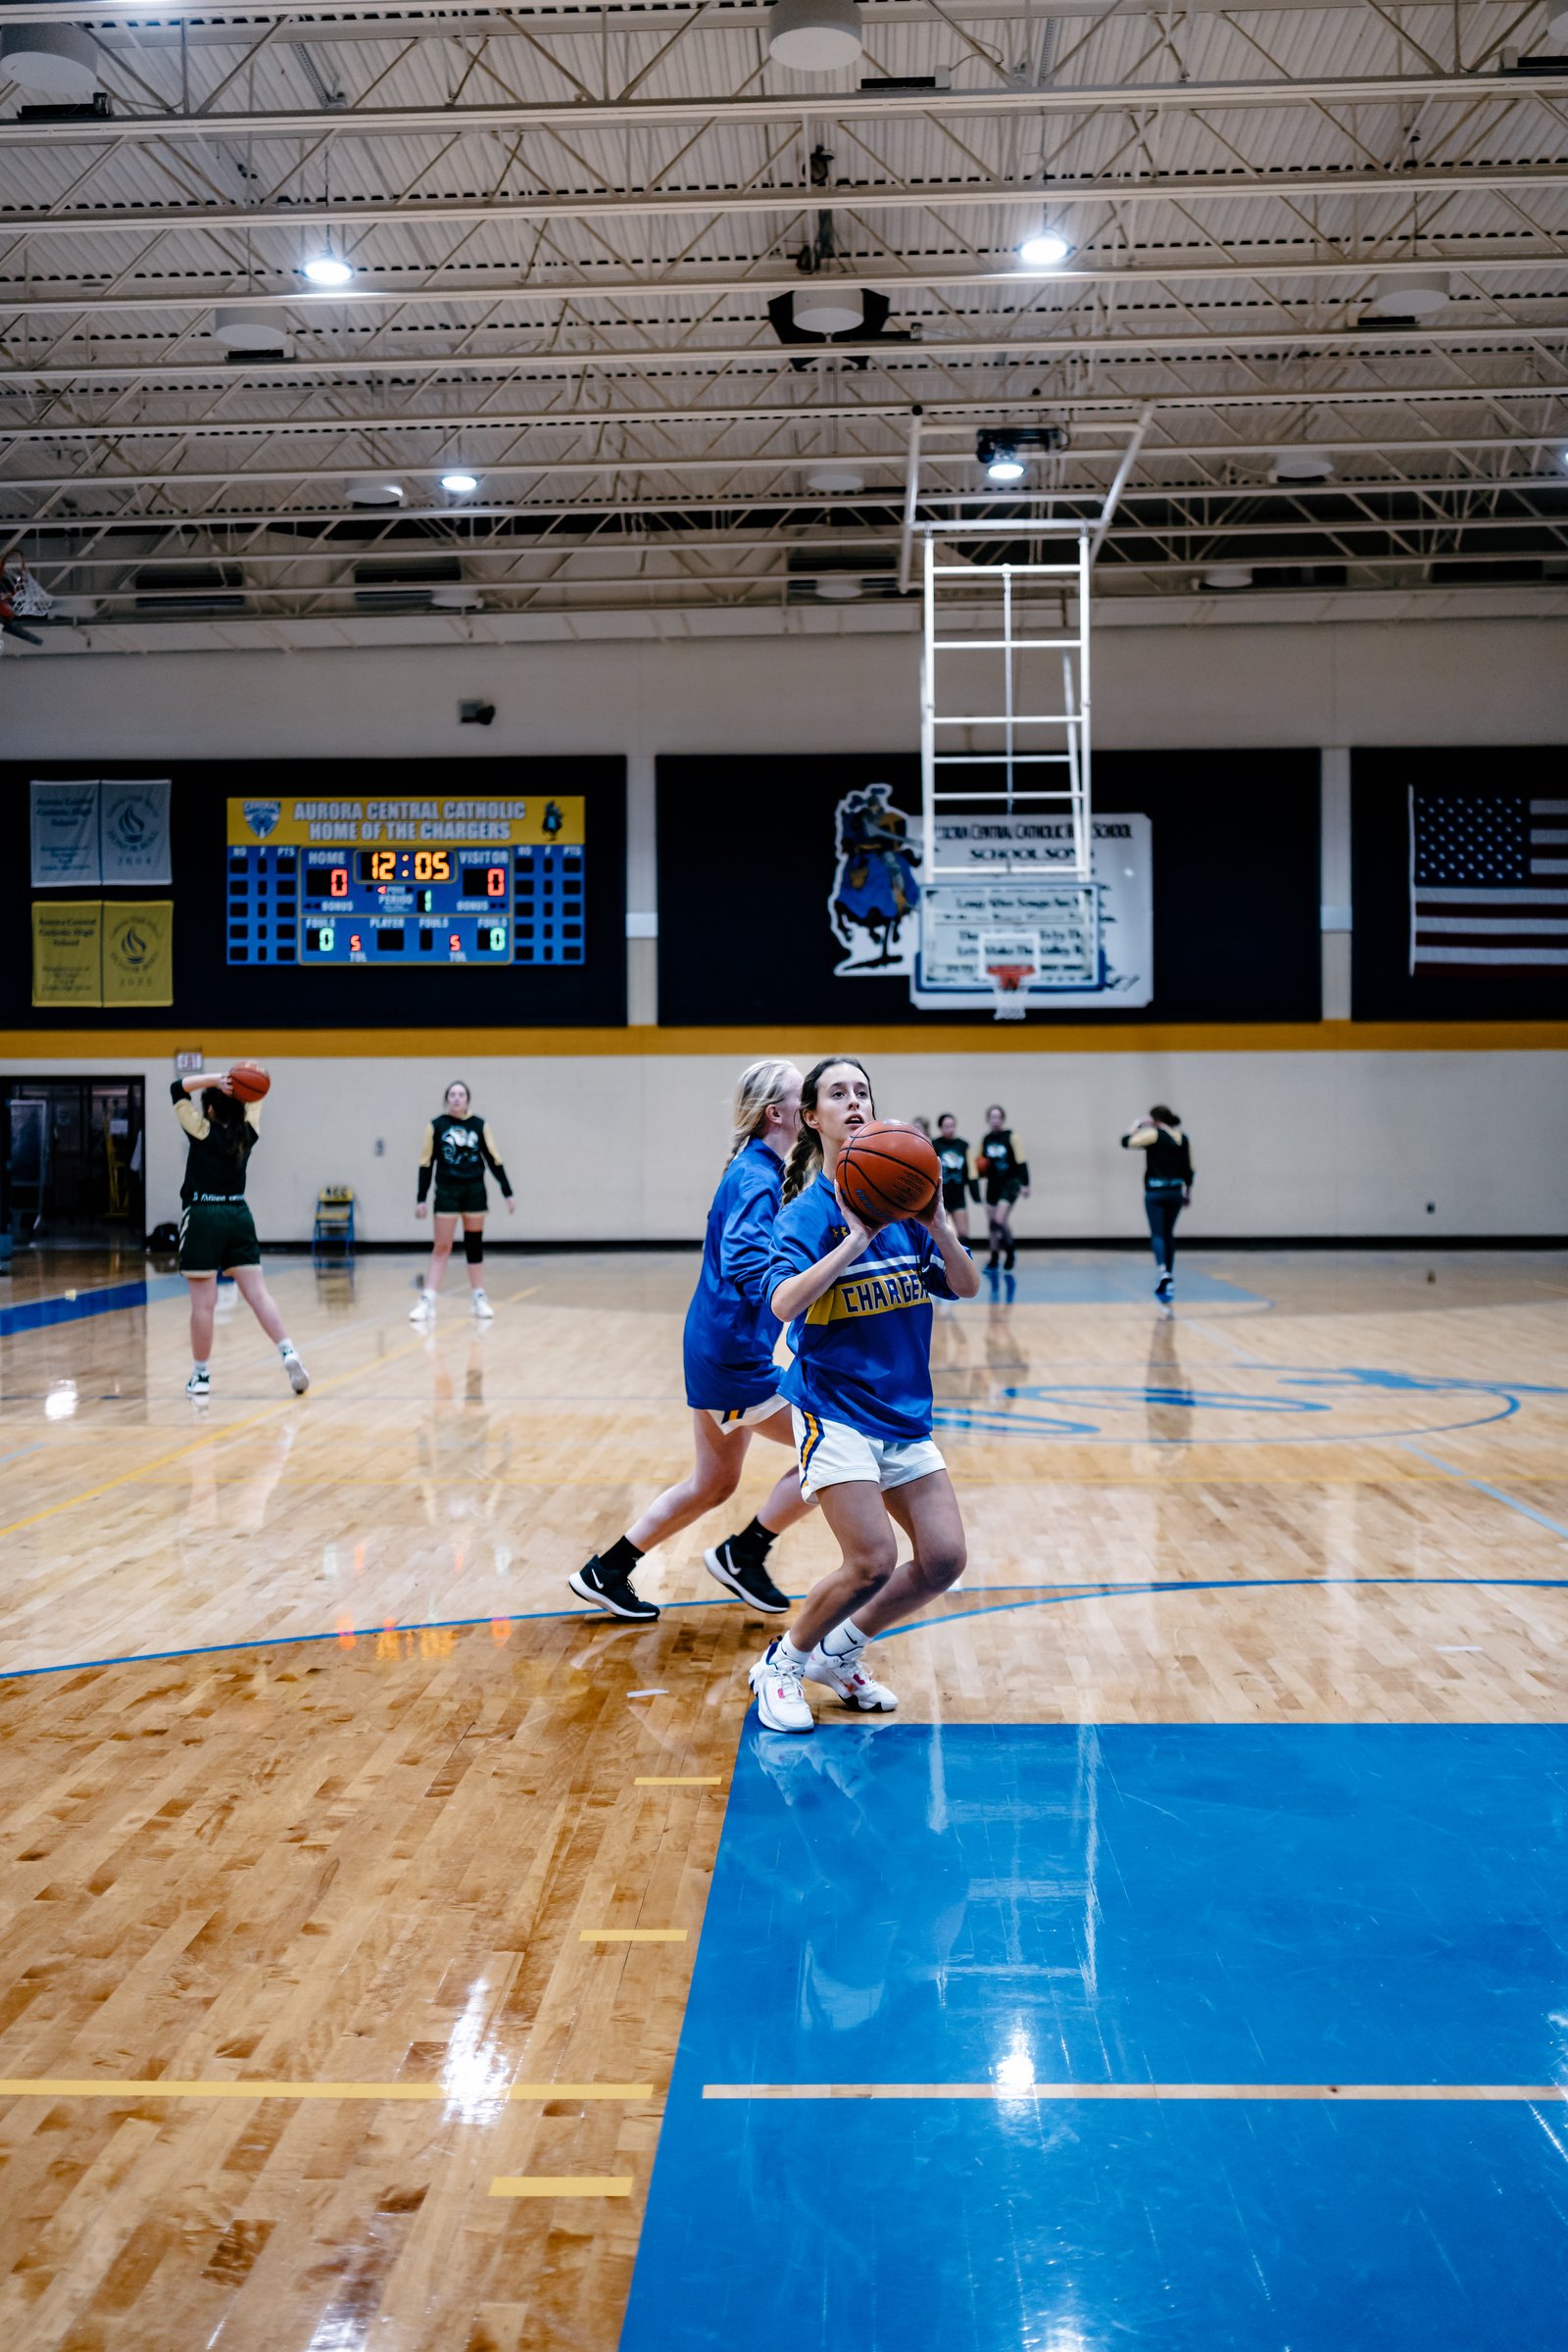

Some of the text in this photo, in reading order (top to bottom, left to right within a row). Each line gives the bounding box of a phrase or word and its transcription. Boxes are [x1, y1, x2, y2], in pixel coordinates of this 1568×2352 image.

[294, 801, 526, 820] AURORA CENTRAL CATHOLIC
[309, 821, 511, 841] HOME OF THE CHARGERS
[309, 851, 346, 864] HOME
[459, 851, 510, 864] VISITOR
[969, 846, 1095, 861] SCHOOL SON
[371, 851, 450, 880] 12:05
[330, 868, 348, 897] 0
[487, 867, 505, 897] 0
[321, 900, 354, 911] BONUS
[424, 890, 432, 912] 1
[457, 900, 488, 911] BONUS
[306, 917, 336, 928] FOULS
[369, 917, 405, 928] PLAYER
[418, 917, 449, 928] FOULS
[477, 917, 508, 928] FOULS
[319, 927, 334, 952] 0
[490, 927, 506, 952] 0
